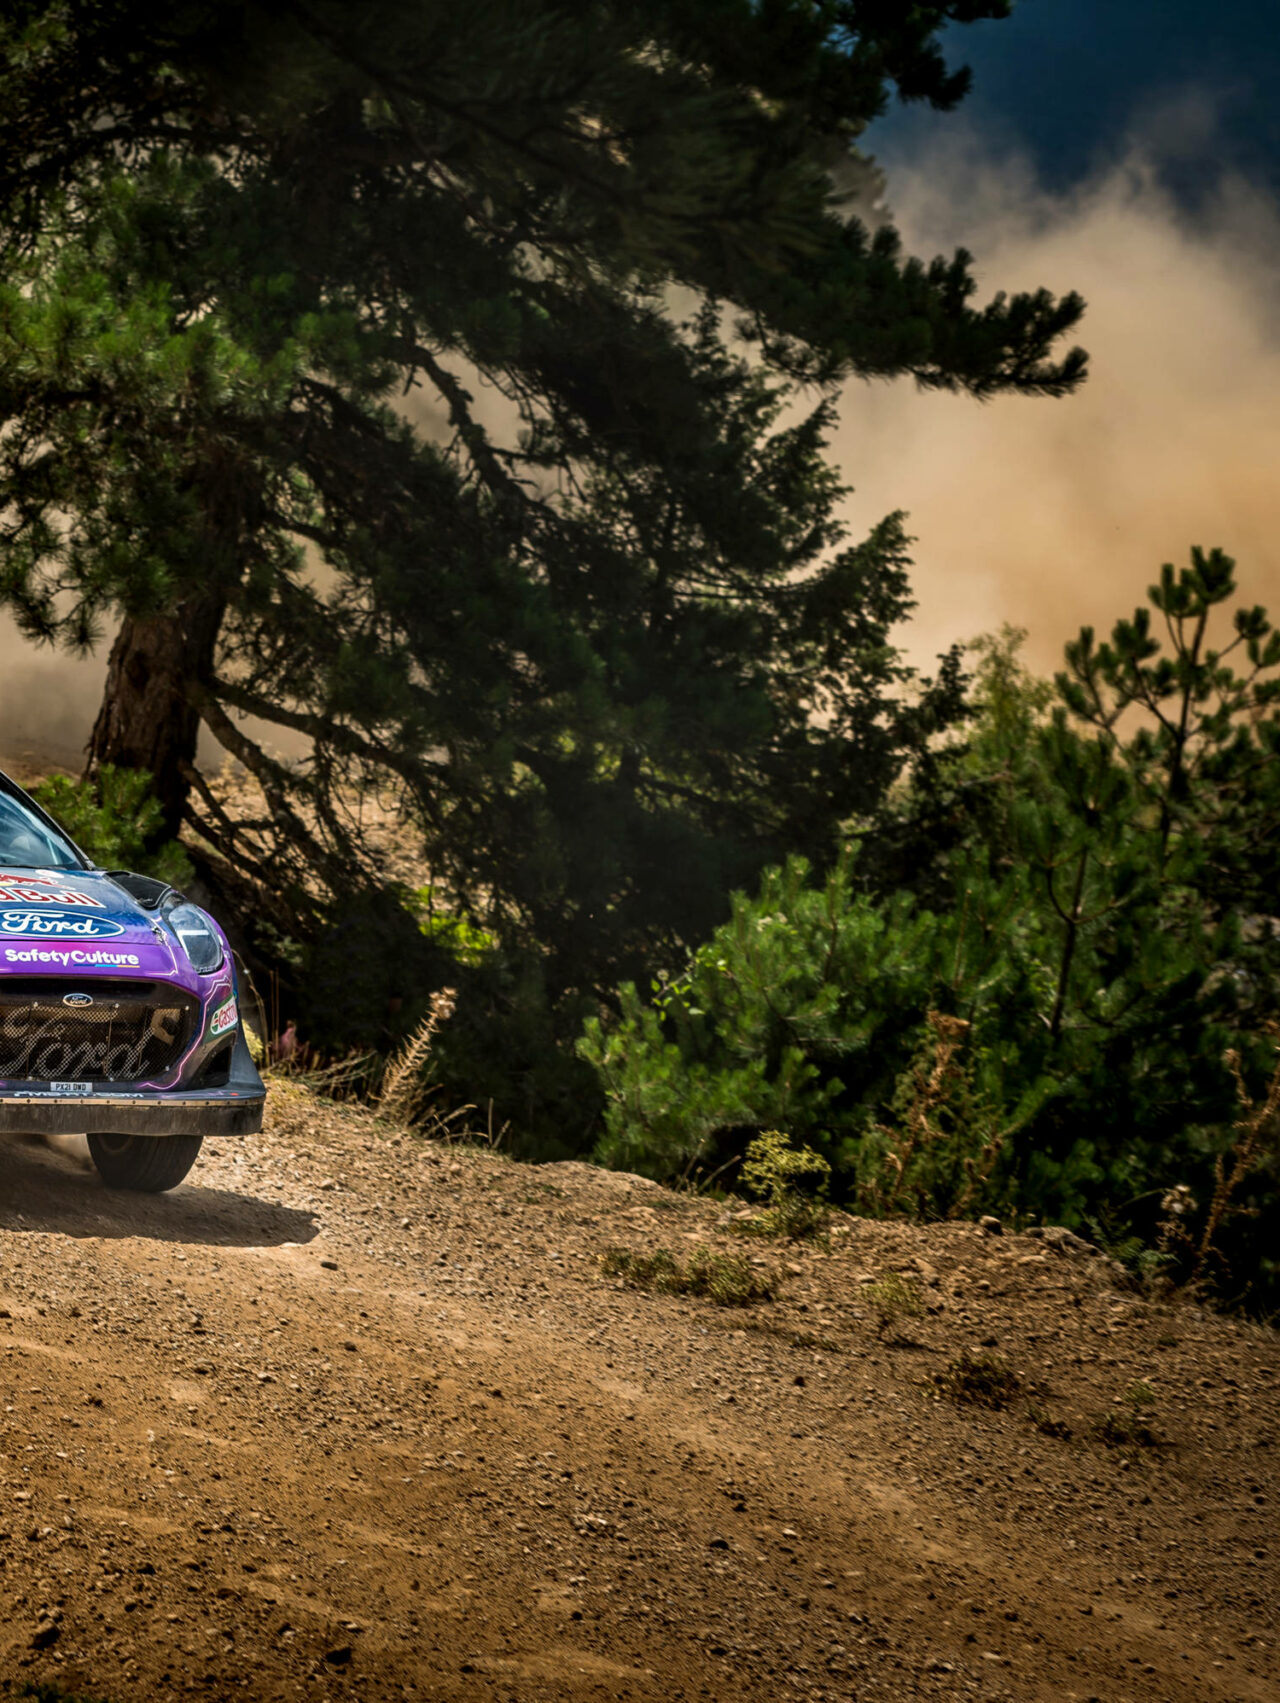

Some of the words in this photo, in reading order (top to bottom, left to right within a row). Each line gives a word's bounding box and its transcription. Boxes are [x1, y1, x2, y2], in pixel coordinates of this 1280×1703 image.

[12, 888, 103, 907] Bull
[1, 911, 101, 934] Ford
[5, 949, 140, 967] SafetyCulture
